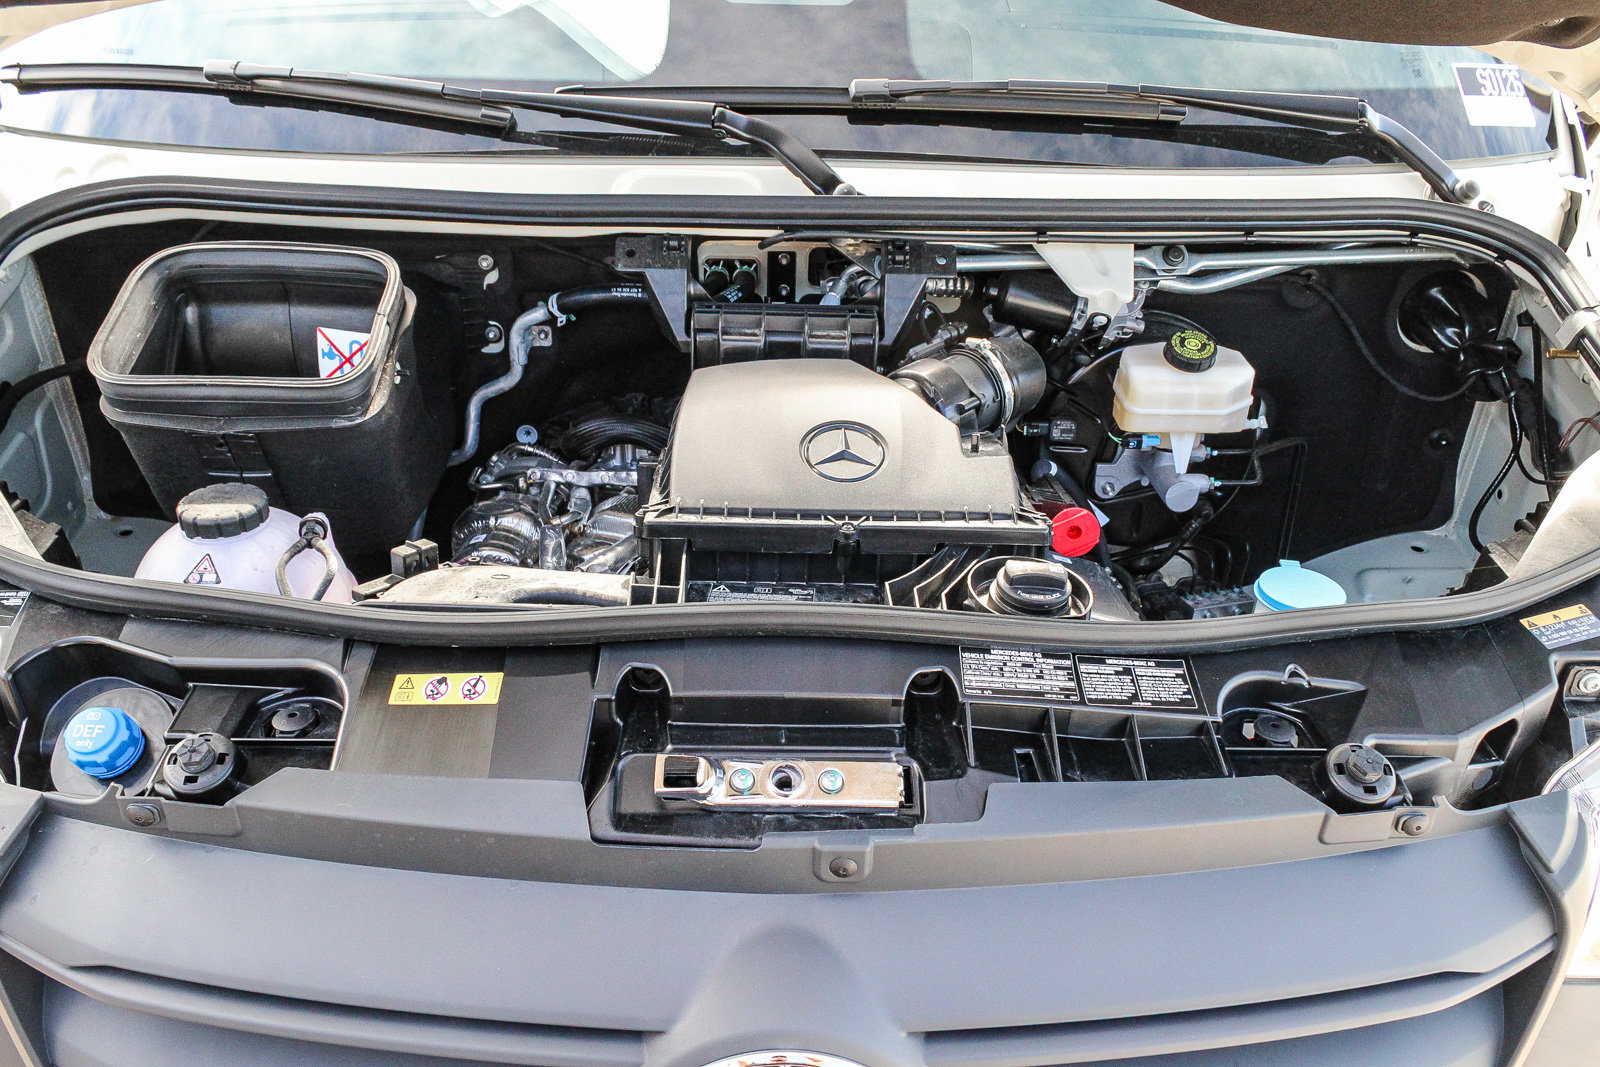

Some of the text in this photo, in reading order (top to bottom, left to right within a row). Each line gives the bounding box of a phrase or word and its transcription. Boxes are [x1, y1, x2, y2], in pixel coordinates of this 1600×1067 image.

[990, 649, 1033, 658] MERCEDES-BENZ
[1011, 655, 1035, 663] CONTROL
[1035, 657, 1071, 665] INFORMATION
[72, 724, 106, 749] DEF only
